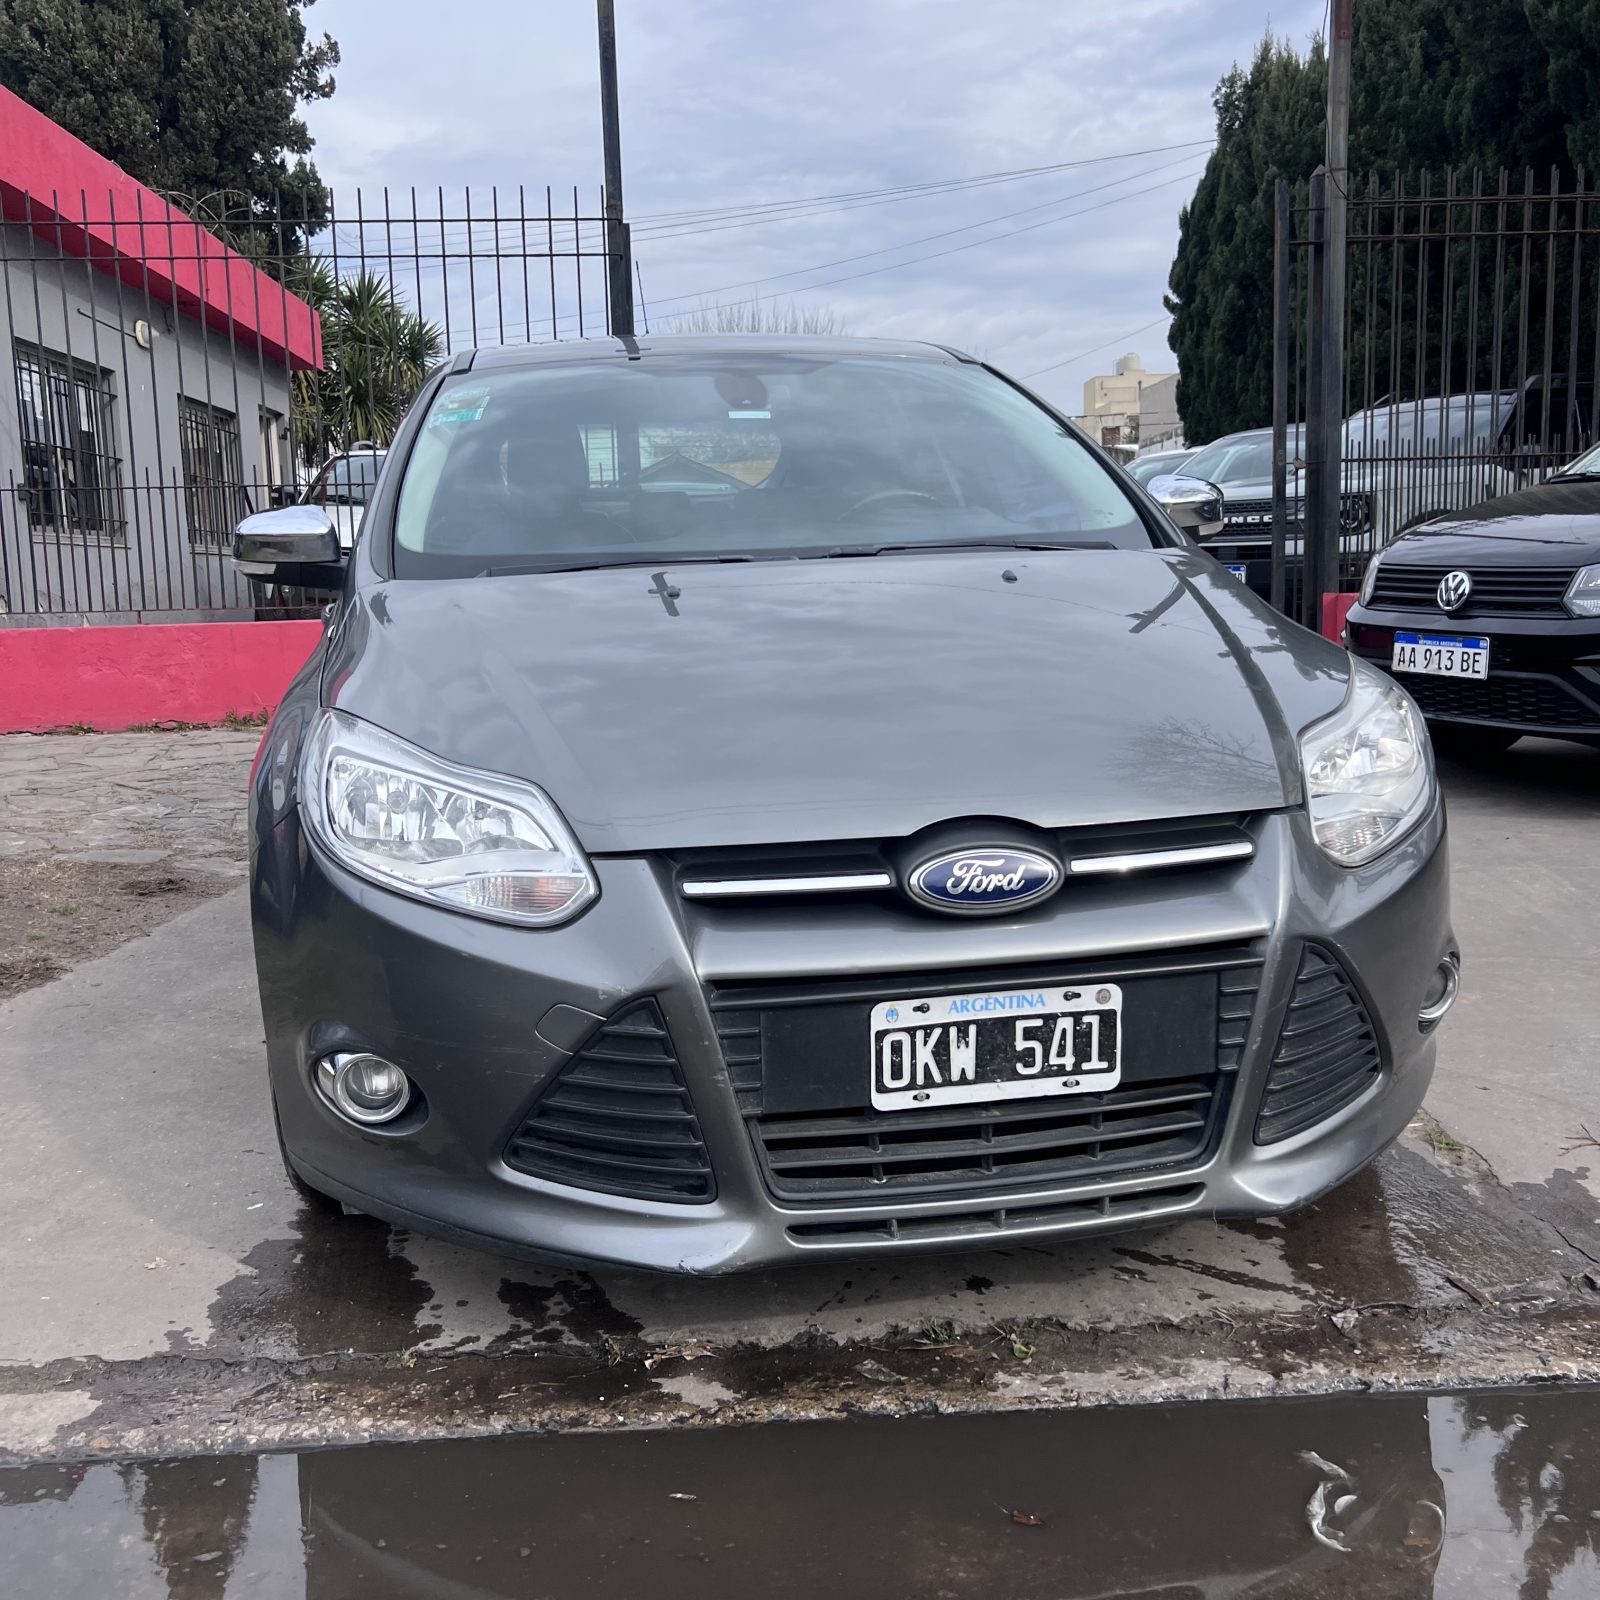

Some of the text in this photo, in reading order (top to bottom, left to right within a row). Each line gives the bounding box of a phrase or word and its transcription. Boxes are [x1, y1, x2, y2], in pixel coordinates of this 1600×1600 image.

[1397, 646, 1482, 674] AA 913 BE
[946, 858, 1026, 895] Ford
[948, 993, 1046, 1015] ARGENTINA
[882, 1014, 1109, 1089] OKW 541
